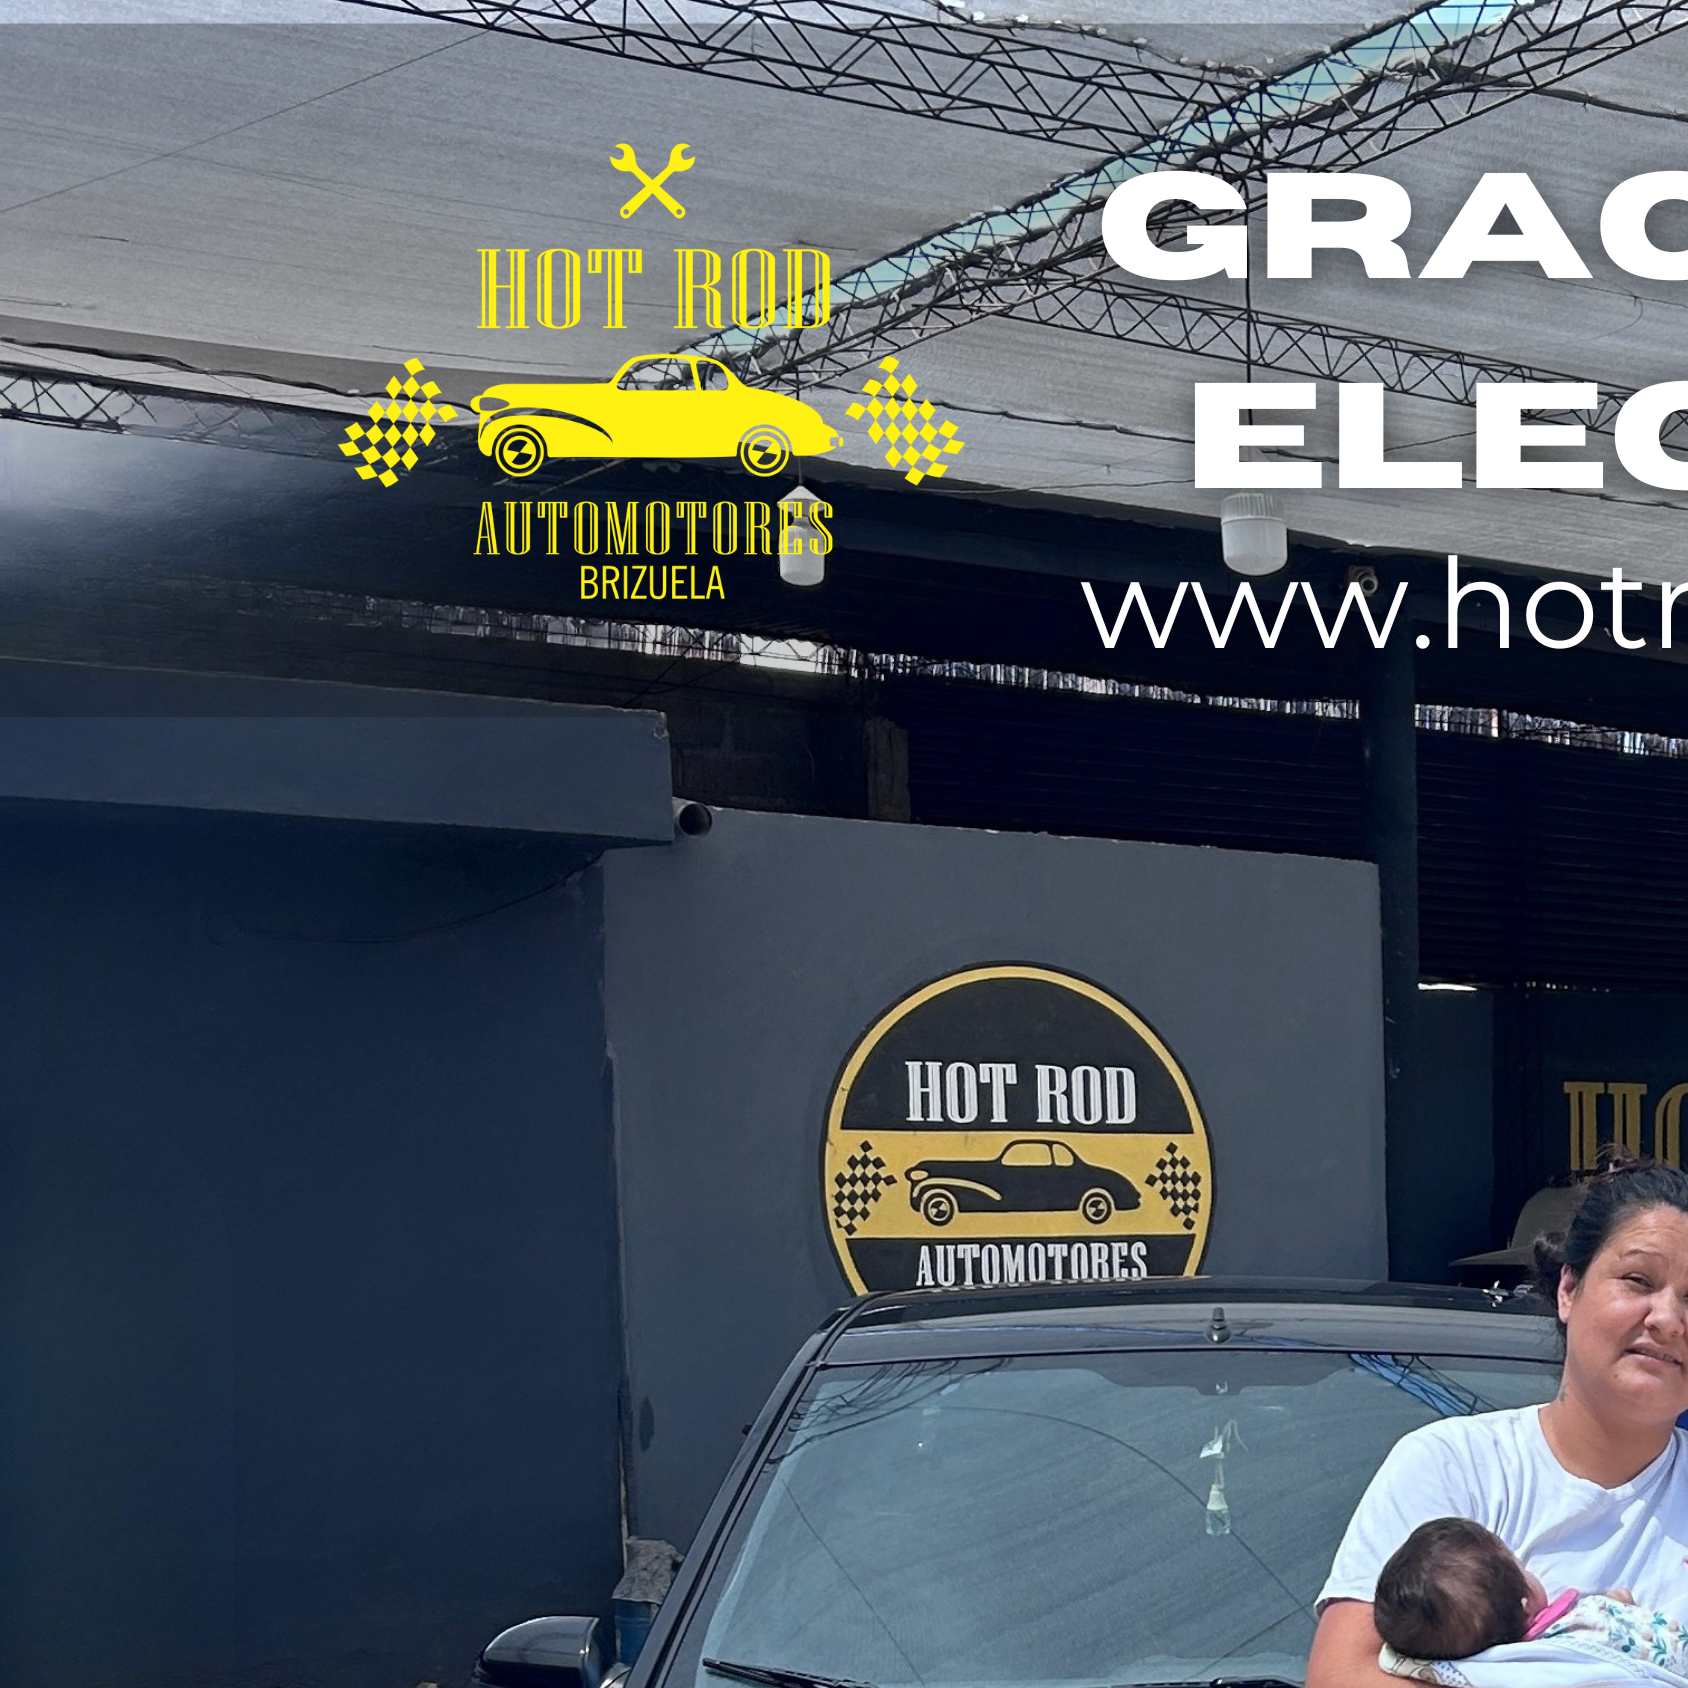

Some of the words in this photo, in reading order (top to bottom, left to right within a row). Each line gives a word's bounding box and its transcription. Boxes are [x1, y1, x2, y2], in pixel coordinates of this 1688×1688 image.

[905, 1061, 1018, 1123] HOT
[1035, 1064, 1136, 1125] ROD
[916, 1241, 1148, 1287] AUTOMOTORES
